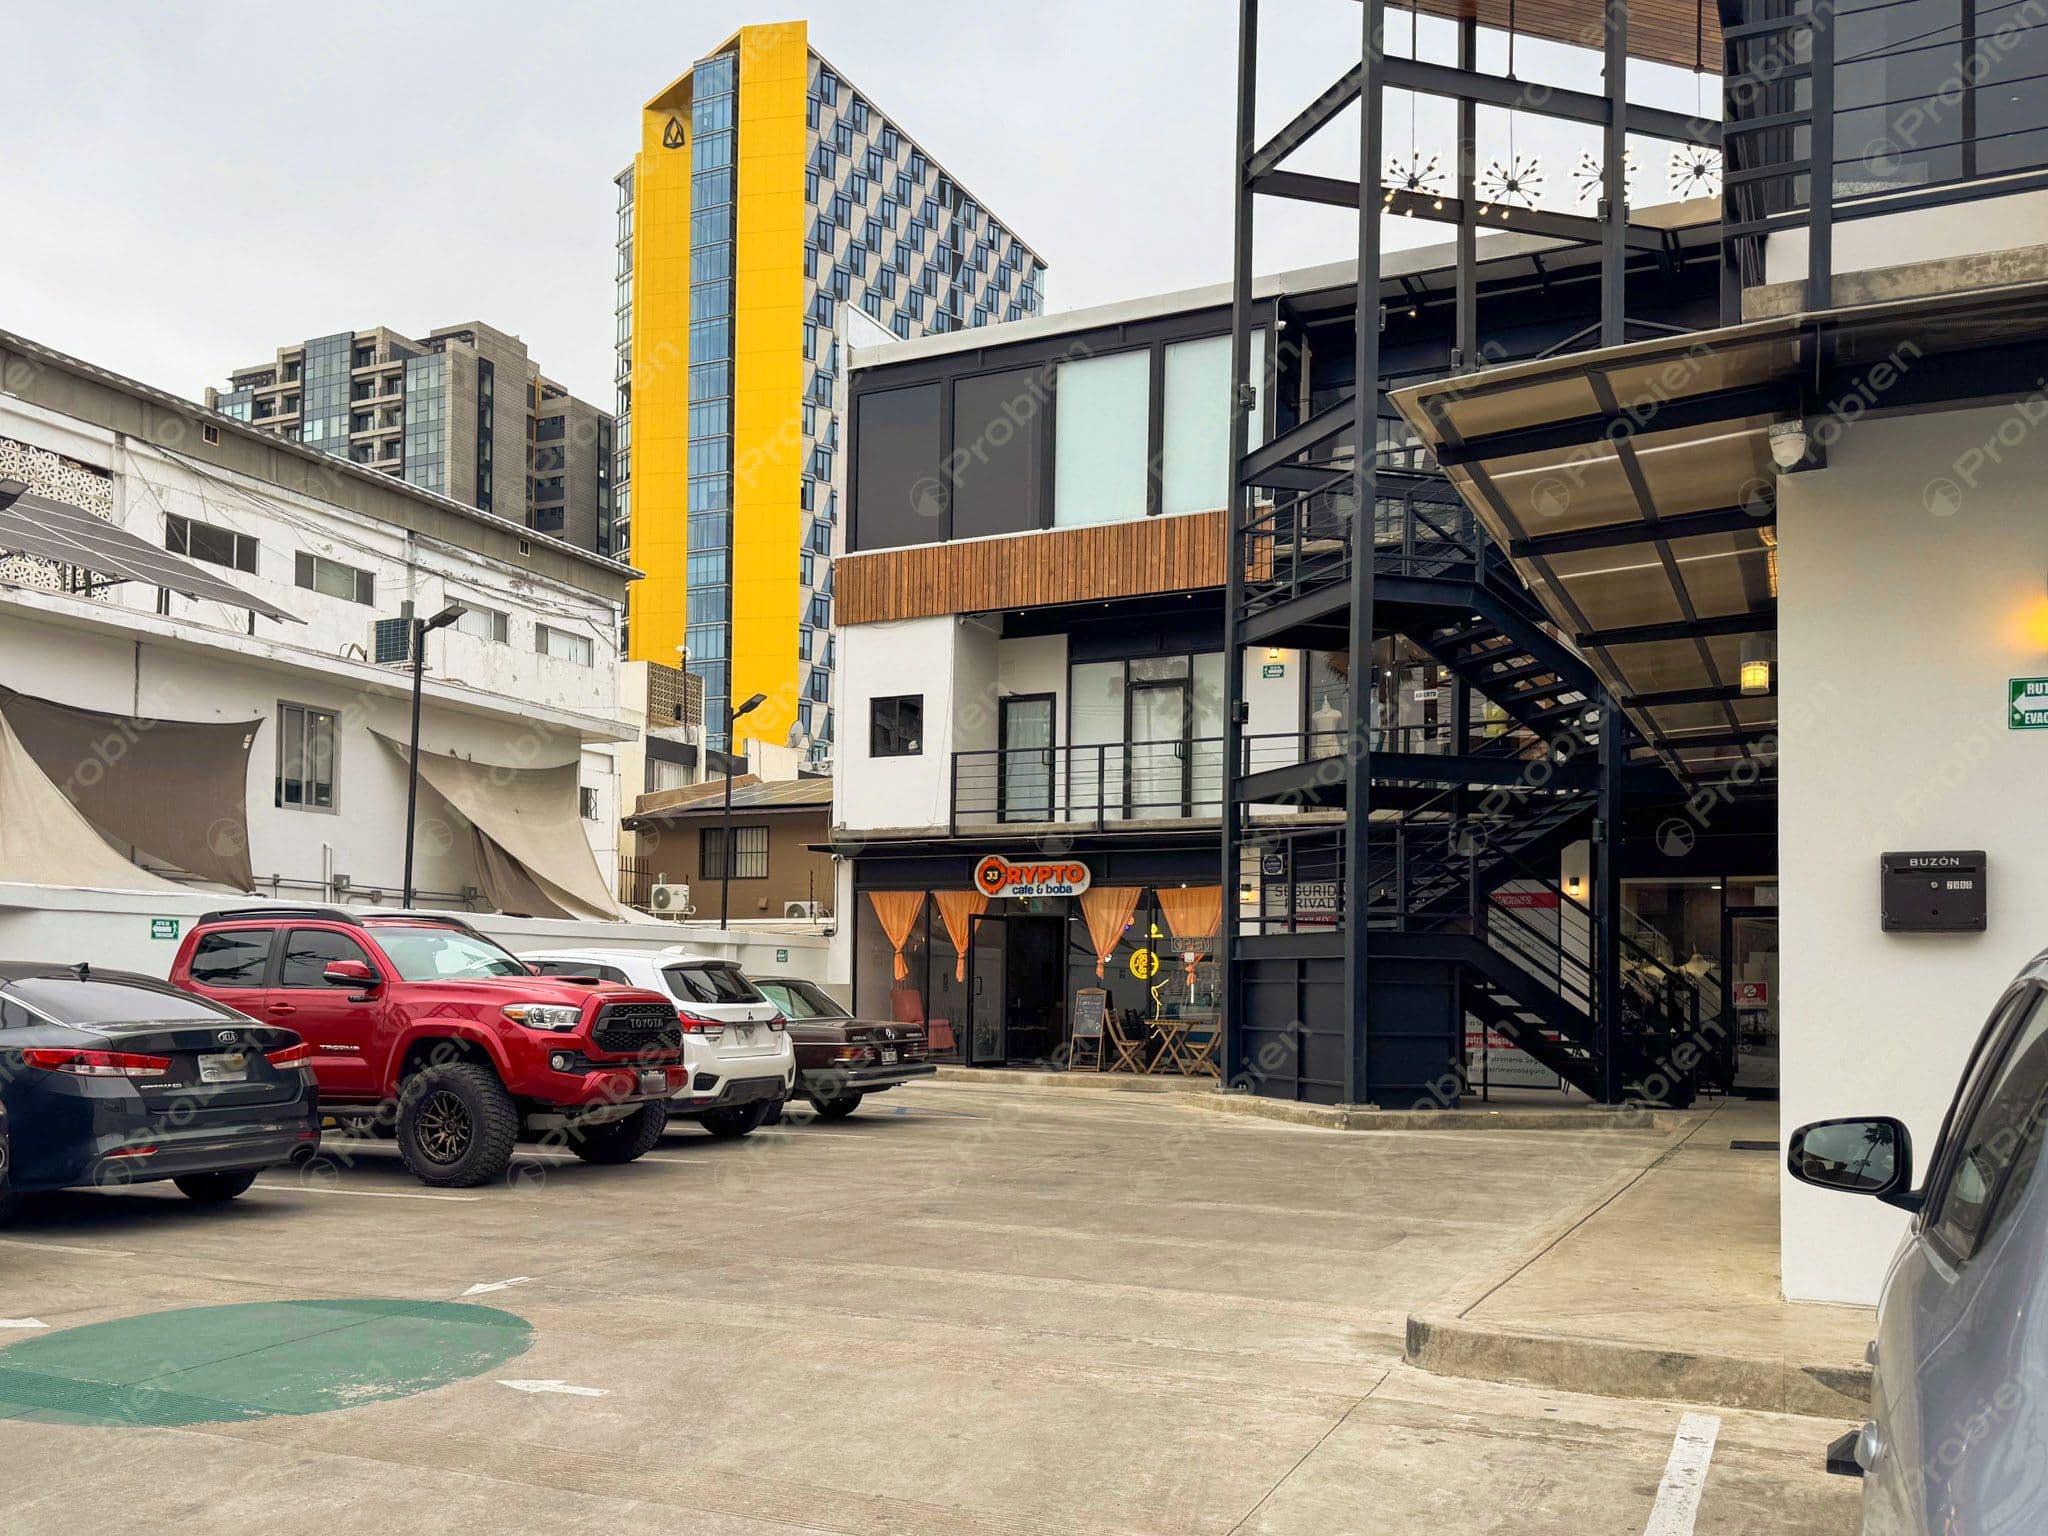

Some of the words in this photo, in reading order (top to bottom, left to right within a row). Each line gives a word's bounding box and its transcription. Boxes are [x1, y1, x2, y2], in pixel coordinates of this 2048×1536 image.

[1909, 856, 1960, 866] BUZÓN
[978, 857, 1084, 894] CRYPTO
[1012, 885, 1033, 895] cafe
[1046, 884, 1073, 894] boba
[630, 1018, 663, 1029] TOYOTA
[221, 1032, 237, 1042] KIA
